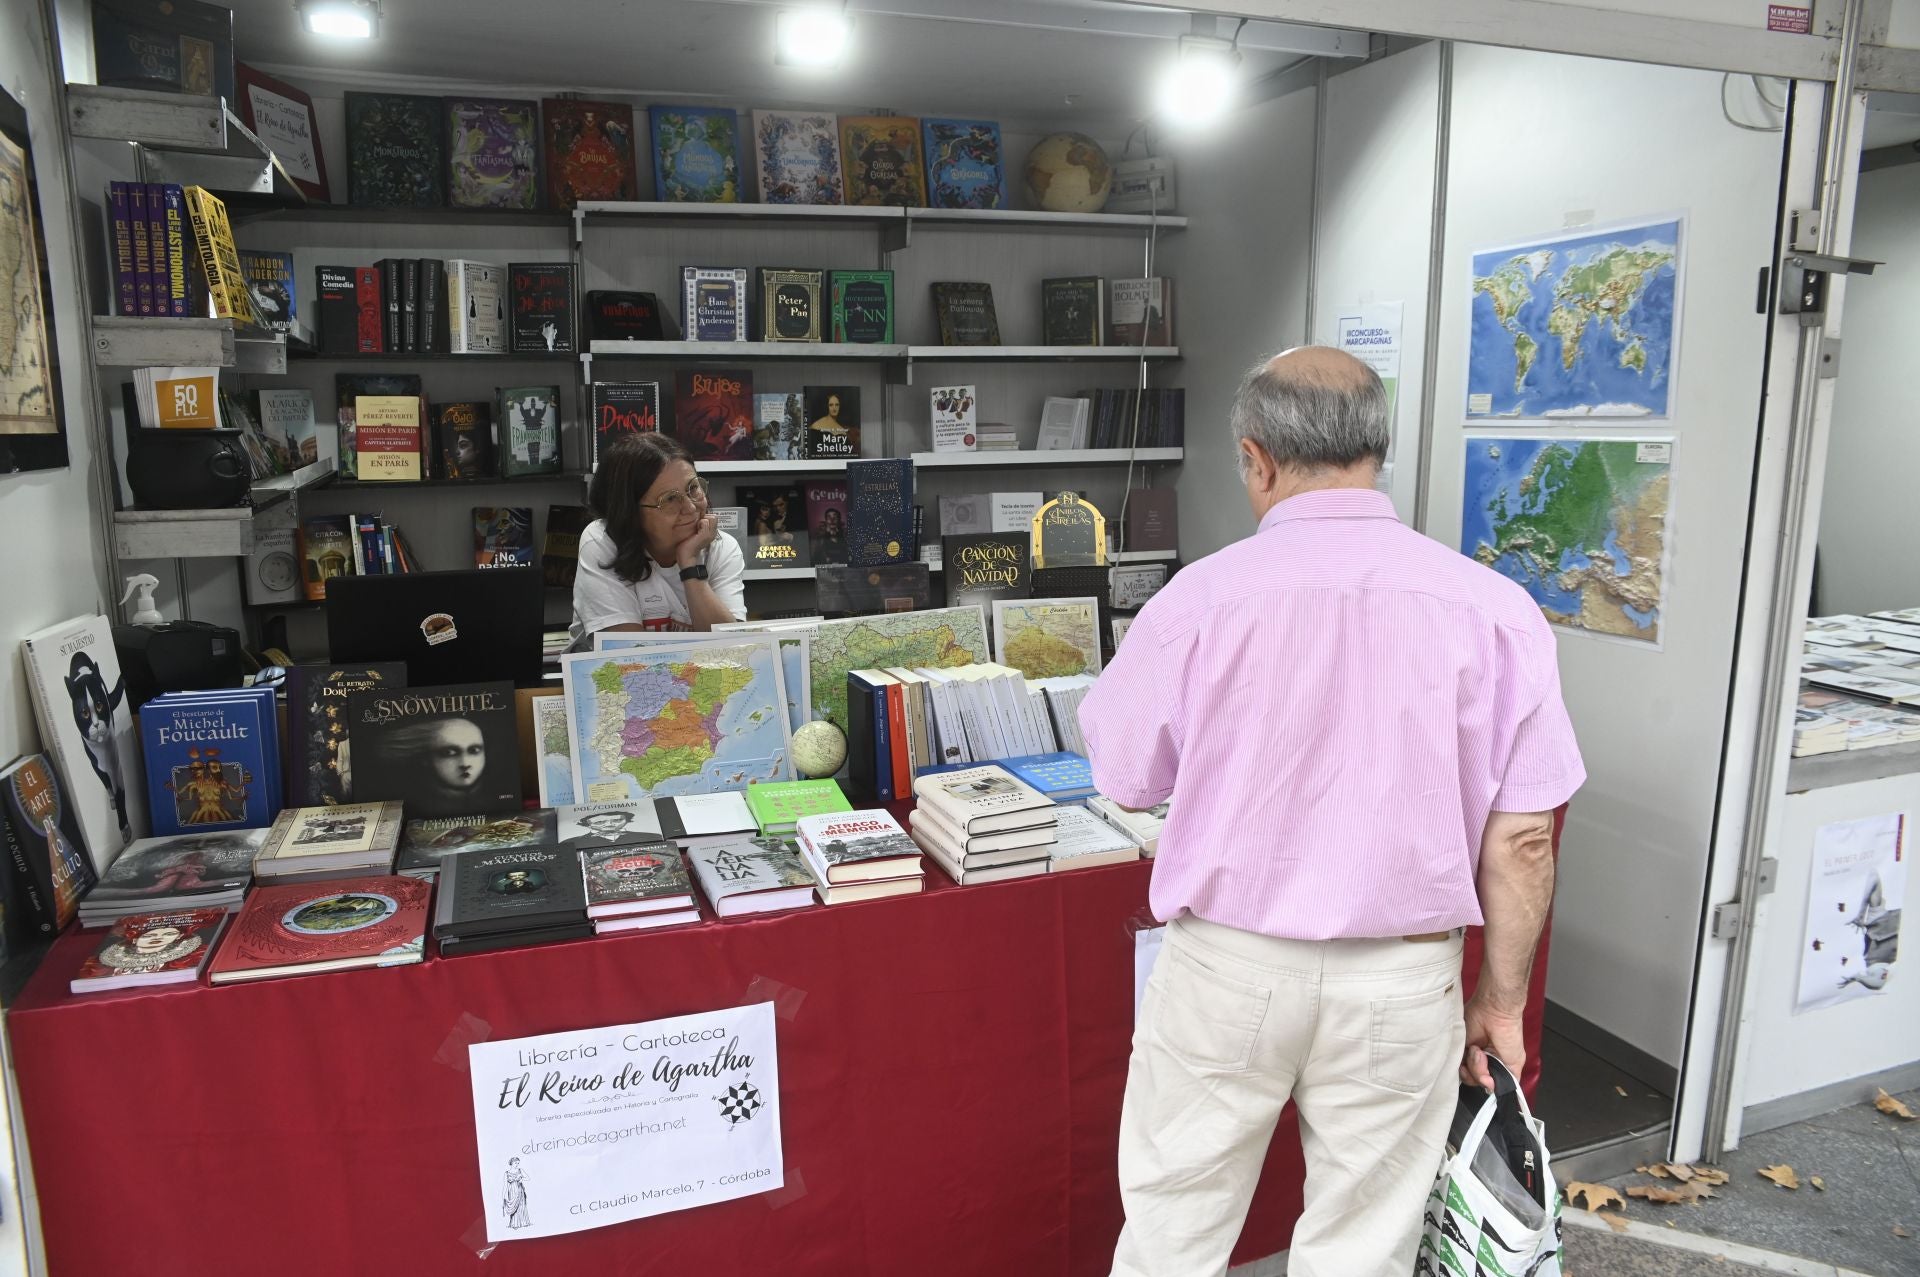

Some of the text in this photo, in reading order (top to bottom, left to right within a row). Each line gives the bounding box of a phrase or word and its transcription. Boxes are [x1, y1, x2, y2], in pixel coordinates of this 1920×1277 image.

[471, 154, 514, 167] FANTASMAS
[580, 152, 608, 165] BRUJAS
[118, 240, 132, 273] BIBLIA
[136, 240, 150, 273] BIBLIA
[153, 240, 166, 273] BIBLIA
[197, 233, 221, 286] MITOLOGIA
[168, 230, 185, 299] ASTRONOMIA
[242, 269, 290, 281] ANDERSON
[322, 273, 346, 282] Divina
[322, 281, 354, 290] Comedia
[707, 297, 728, 307] Hans
[778, 294, 803, 305] Peter
[698, 306, 734, 316] Christian
[790, 307, 808, 318] Pan
[699, 316, 735, 326] Andersen
[691, 373, 742, 399] Brujas
[174, 384, 198, 404] 50
[175, 402, 198, 417] FLC
[360, 426, 387, 434] MISIÓN
[398, 426, 417, 434] PARÍS
[822, 434, 848, 445] Mary
[816, 443, 854, 454] Shelley
[371, 457, 410, 468] EN PARÍS
[810, 488, 848, 502] Genio
[494, 552, 516, 564] ¡No
[755, 550, 797, 559] AMORES
[961, 544, 1019, 564] CANCIÓN
[982, 561, 997, 571] DE
[962, 566, 1019, 588] NAVIDAD
[1123, 581, 1146, 592] Mitos
[346, 680, 375, 688] RETRATO
[376, 692, 500, 718] SNOWHITE
[172, 708, 225, 719] El bestiario de
[174, 716, 226, 731] Michel
[159, 724, 250, 746] Foucault
[25, 770, 38, 788] EL
[30, 792, 52, 816] ARTE
[968, 791, 1025, 805] IMAGINAR
[998, 796, 1026, 805] VIDA
[43, 814, 57, 834] DE
[825, 823, 893, 837] MEMORIA
[827, 820, 880, 831] ATRACO
[52, 838, 64, 858] LO
[593, 848, 629, 857] MICHAEL
[474, 854, 557, 868] MACABROS
[494, 852, 544, 860] CUENTOS
[51, 855, 82, 890] OCULTO
[604, 860, 664, 871] OSCURA
[518, 1044, 598, 1068] Librería
[622, 1025, 727, 1054] Cartoteca
[498, 1034, 755, 1111] El Reino de Agartha
[521, 1115, 688, 1157] elreinodeagartha.net
[568, 1202, 587, 1216] Cl.
[588, 1192, 639, 1213] Claudio
[640, 1183, 695, 1203] Marcelo,
[697, 1179, 706, 1192] 7
[718, 1165, 772, 1189] Córdoba
